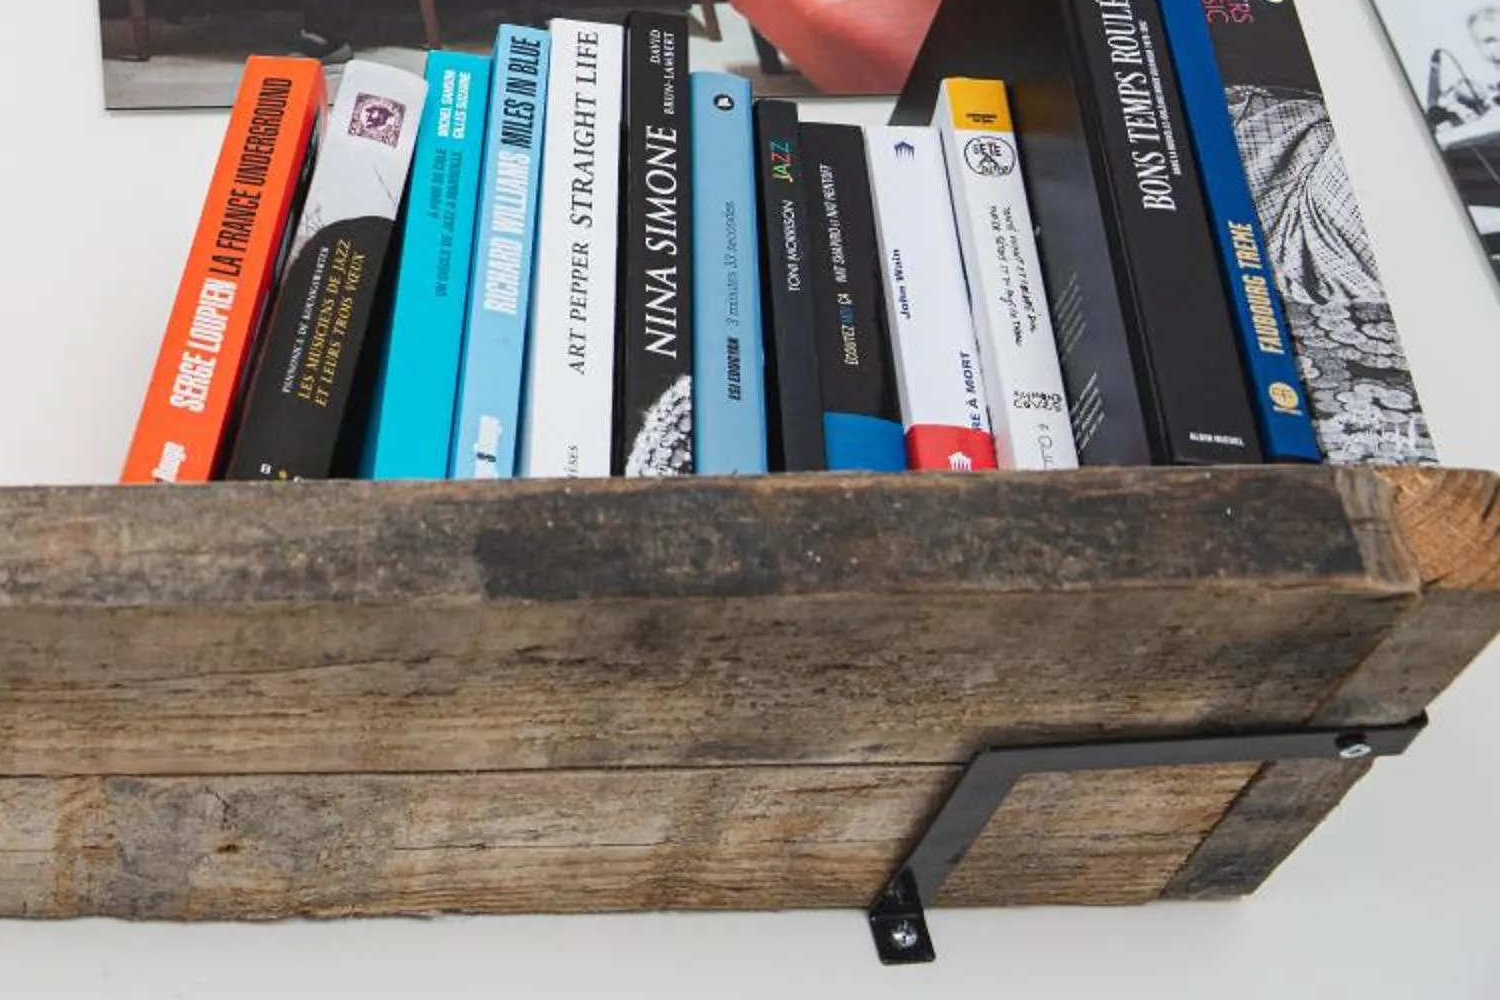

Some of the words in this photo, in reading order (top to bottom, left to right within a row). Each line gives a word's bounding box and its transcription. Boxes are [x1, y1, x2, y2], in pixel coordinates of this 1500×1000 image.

[508, 36, 541, 76] BLUE
[576, 31, 599, 86] LIFE
[650, 29, 661, 64] DAVID
[664, 31, 675, 116] BRUN-LAMBERT
[505, 78, 538, 97] IN
[1114, 70, 1161, 144] TEMPS
[234, 77, 293, 187] UNDERGROUND
[500, 100, 536, 149] MILES
[492, 149, 531, 234] WILLIAMS
[570, 93, 597, 229] STRAIGHT
[645, 125, 677, 256] SIMONE
[770, 140, 793, 184] JAZZ
[1131, 150, 1177, 212] BONS
[216, 188, 262, 252] FRANCE
[781, 199, 800, 263] MORRISON
[1227, 220, 1263, 270] TREME
[209, 253, 245, 277] LA
[326, 276, 341, 295] DE
[332, 239, 352, 275] JAZZ
[484, 236, 524, 316] RICHARD
[569, 241, 590, 322] PEPPER
[785, 264, 801, 292] TONI
[891, 249, 906, 281] Wain
[187, 277, 238, 354] LOUPIEN
[305, 297, 335, 371] MUSICIENS
[645, 267, 677, 360] NINA
[898, 286, 911, 320] John
[1242, 274, 1285, 355] FAUBOURG
[169, 351, 218, 413] SERGE
[314, 387, 329, 408] ET
[322, 339, 342, 384] LEURS
[333, 294, 354, 336] TROIS
[568, 327, 586, 375] ART
[960, 350, 976, 394] MORT
[297, 379, 317, 400] LES
